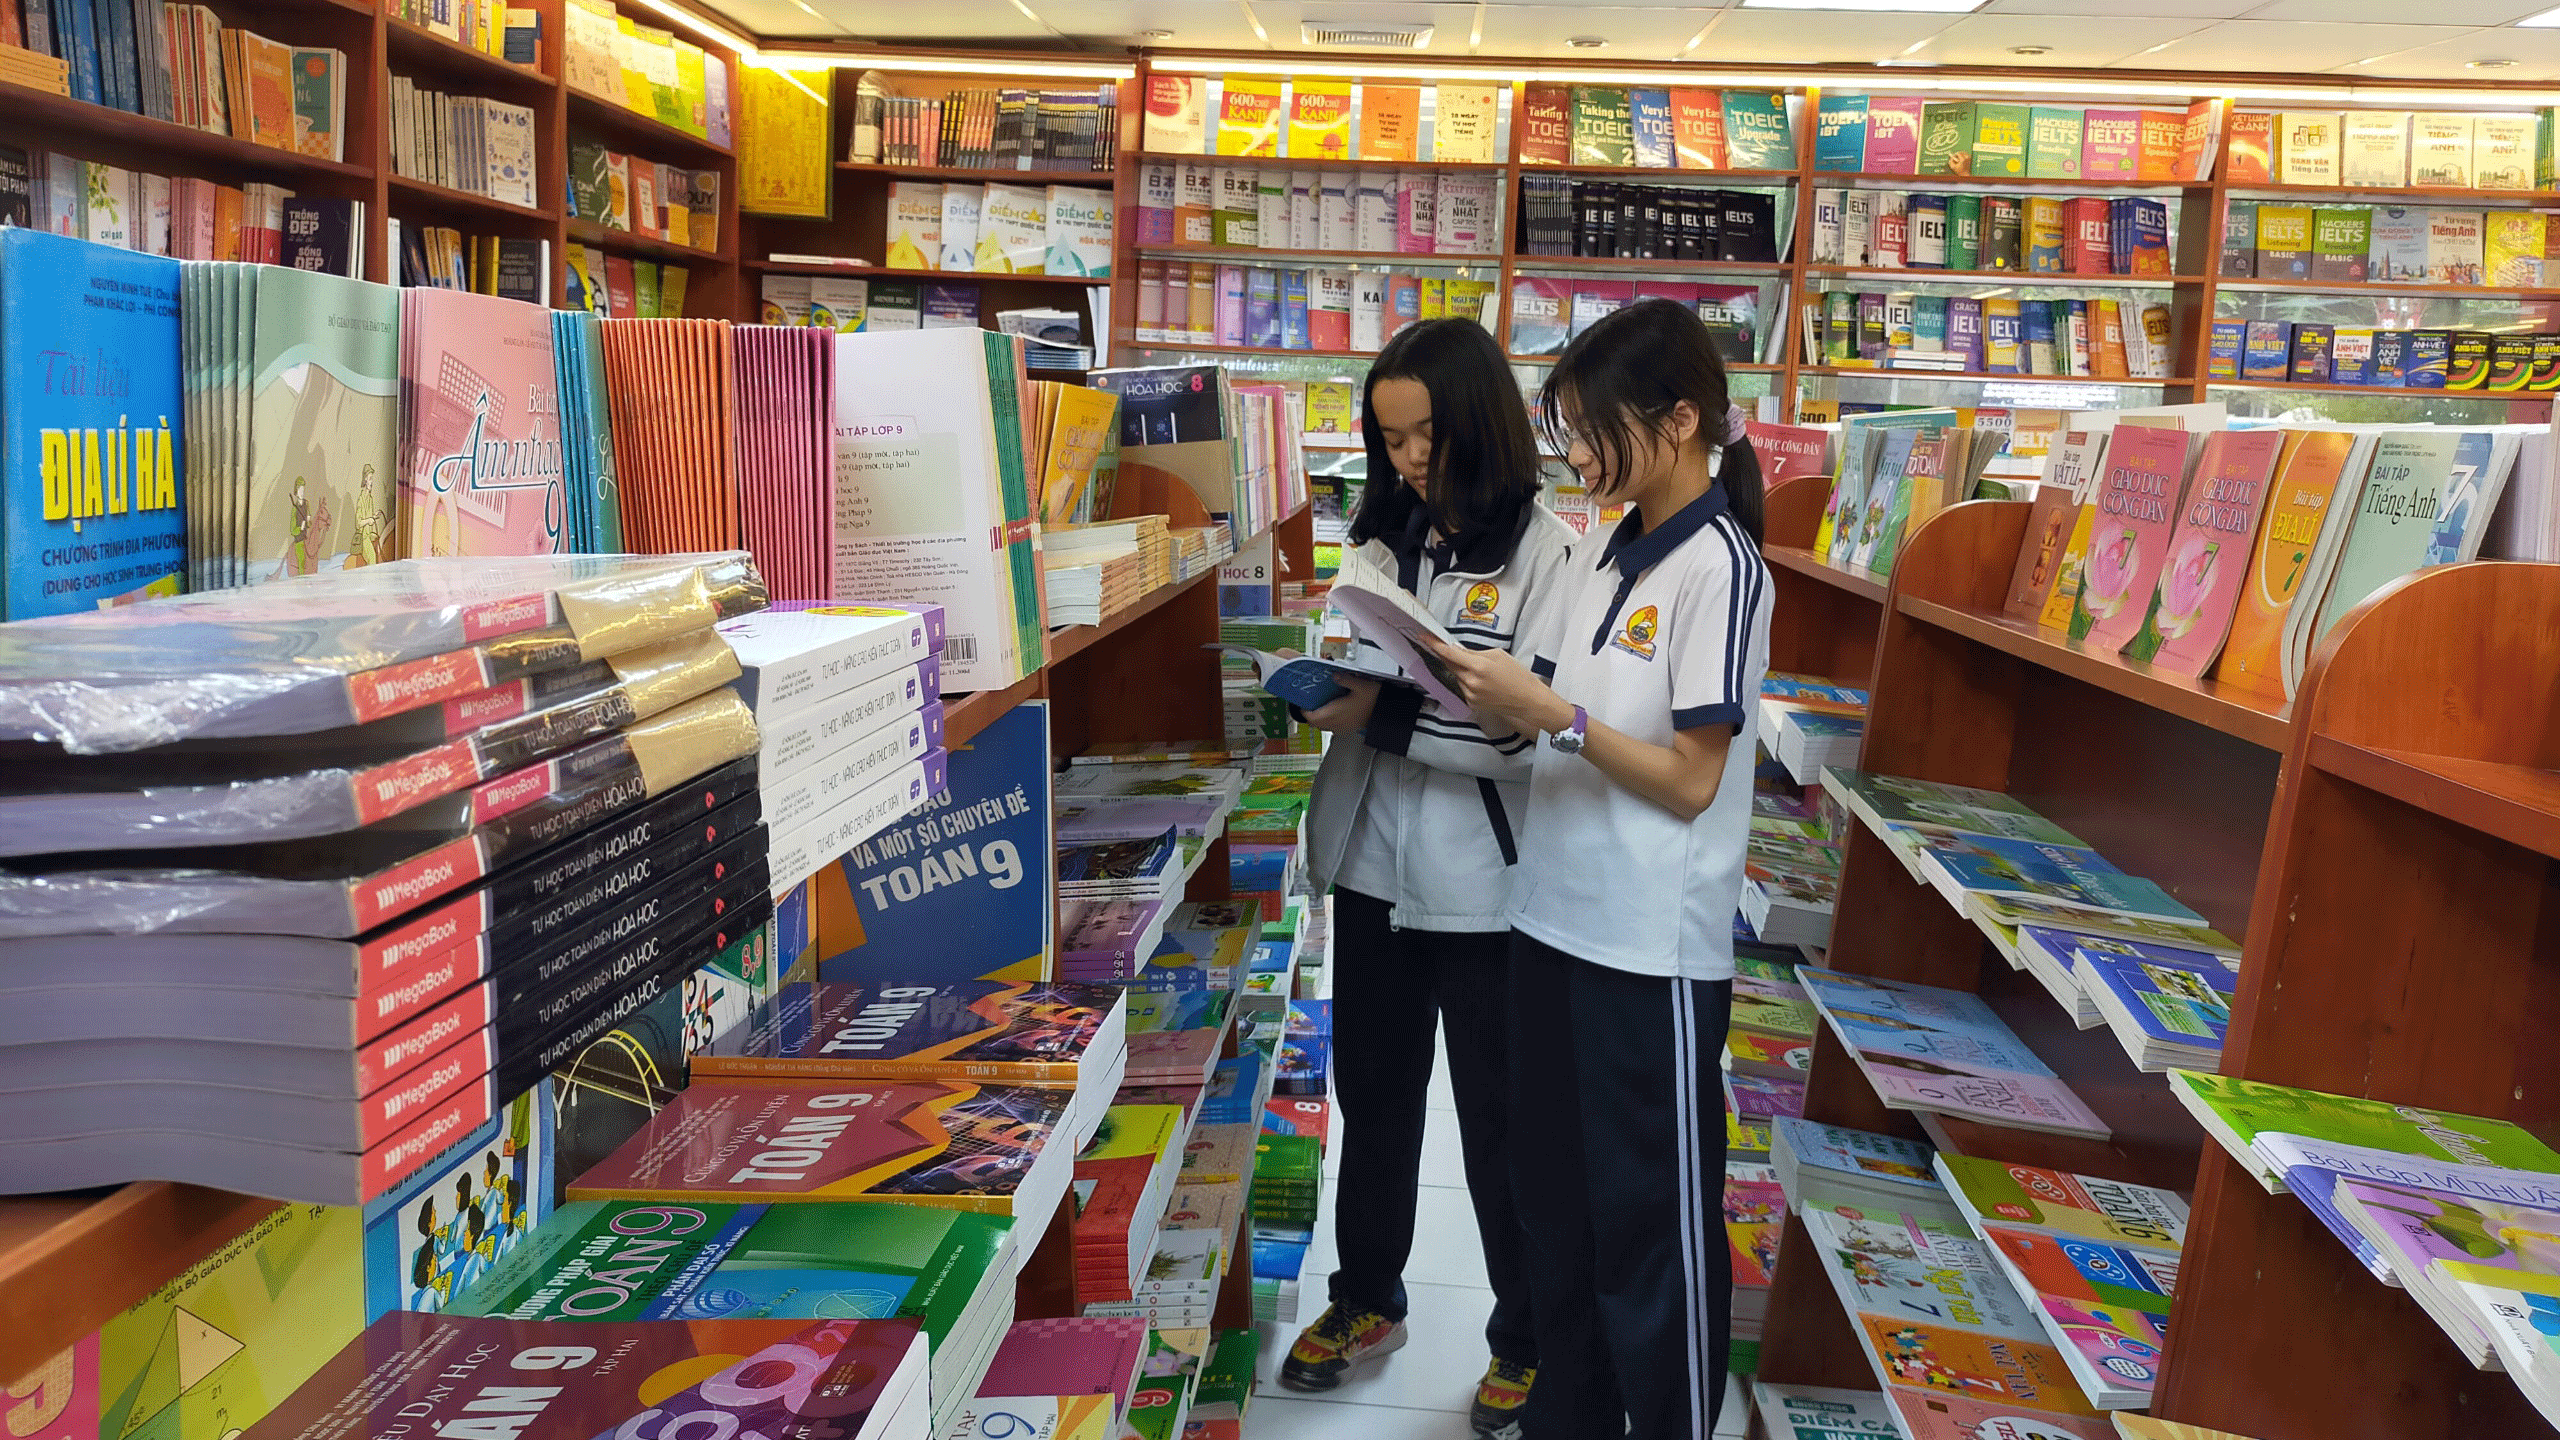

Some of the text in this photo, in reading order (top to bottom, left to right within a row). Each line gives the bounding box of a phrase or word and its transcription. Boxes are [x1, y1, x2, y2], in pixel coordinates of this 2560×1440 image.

[1230, 94, 1254, 107] 600
[1300, 94, 1324, 108] 600
[1641, 104, 1659, 117] Very
[1529, 106, 1563, 119] Taking
[1580, 104, 1614, 119] Taking
[1682, 105, 1703, 118] Very
[1730, 109, 1785, 129] TOEIC
[1579, 118, 1632, 138] TOEIC
[2033, 126, 2078, 144] IELTS
[2088, 129, 2136, 144] IELTS
[1622, 148, 1634, 164] 2
[1056, 203, 1085, 219] ĐIỂM
[1725, 210, 1754, 224] IELTS
[2136, 206, 2165, 227] IELTS
[1882, 223, 1907, 242] IELT
[2080, 220, 2110, 242] IELT
[2263, 226, 2305, 240] IELTS
[2319, 228, 2365, 242] IELTS
[2432, 225, 2457, 237] Tiếng
[2458, 226, 2476, 236] Anh
[2324, 254, 2353, 262] BASIC
[1513, 297, 1559, 316] IELTS
[1699, 307, 1745, 323] IELTS
[1991, 319, 2020, 338] IELT
[1191, 374, 1204, 392] 8
[528, 384, 544, 413] Bài
[897, 426, 902, 434] 9
[1977, 417, 2013, 428] 5500
[39, 427, 103, 532] ĐỊA
[135, 416, 176, 512] HÀ
[1773, 456, 1786, 474] 7
[2373, 465, 2410, 484] BÀI TẬP
[2072, 478, 2086, 506] 7
[2436, 465, 2479, 523] 7
[2364, 483, 2437, 525] Tiếng Anh
[2273, 510, 2302, 542] ĐỊA
[2118, 529, 2137, 569] 7
[1223, 565, 1264, 580] HỌC 8
[2196, 541, 2220, 586] 7
[2283, 551, 2305, 592] 7
[499, 774, 541, 802] MegaBook
[881, 782, 1031, 859] MỘT SỐ CHUYÊN ĐỀ
[630, 822, 651, 847] HỌC
[393, 860, 454, 901] MegaBook
[629, 858, 651, 885] HỌC
[860, 839, 1024, 913] TOÁN 9
[637, 899, 659, 927] HỌC
[399, 918, 457, 957] MegaBook
[637, 937, 659, 963] HỌC
[396, 962, 454, 1008] MegaBook
[637, 974, 661, 1001] HỌC
[819, 987, 937, 1054] TOÁN 9
[399, 1011, 461, 1058] MegaBook
[965, 1063, 998, 1076] TOÁN 9
[400, 1060, 462, 1107] MegaBook
[400, 1107, 461, 1157] MegaBook
[728, 1093, 873, 1184] TOÁN 9
[2299, 1149, 2359, 1173] Bài
[2366, 1160, 2423, 1188] tập
[610, 1206, 707, 1235] 9
[200, 1260, 222, 1280] GIÁO
[445, 1343, 499, 1380] HỌC
[510, 1346, 598, 1371] 9
[981, 1411, 1035, 1438] 9
[1788, 1409, 1854, 1429] ĐIỂM
